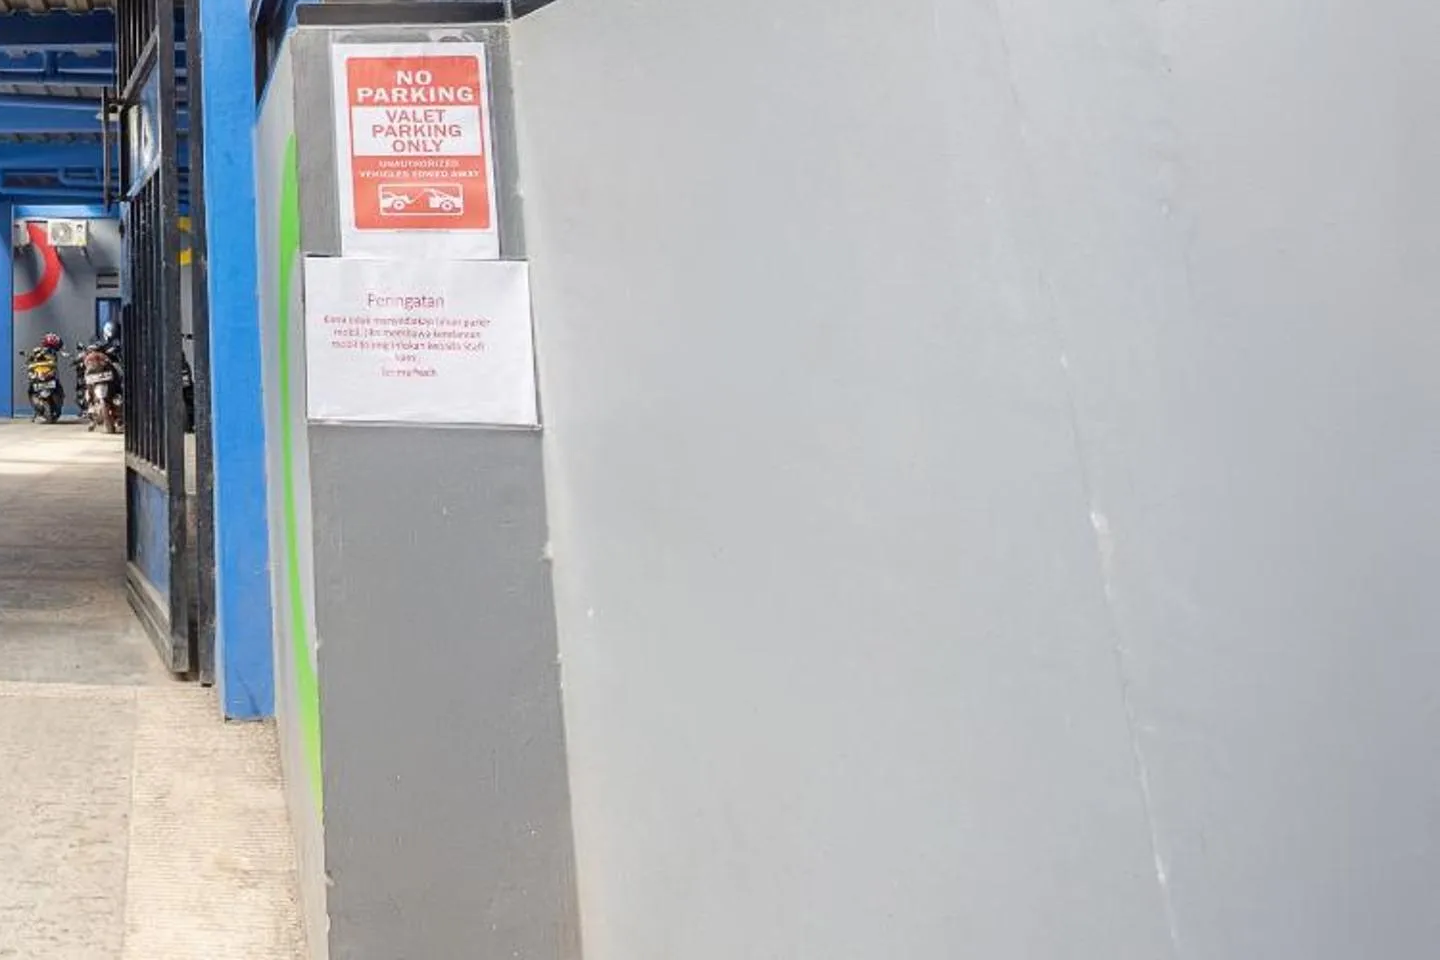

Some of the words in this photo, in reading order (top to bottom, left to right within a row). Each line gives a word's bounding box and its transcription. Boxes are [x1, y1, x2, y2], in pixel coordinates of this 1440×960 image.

[396, 70, 433, 85] NO
[357, 87, 473, 103] PARKING
[385, 109, 446, 123] VALET
[372, 123, 462, 138] PARKING
[392, 139, 444, 153] ONLY
[368, 293, 445, 310] Peringatan
